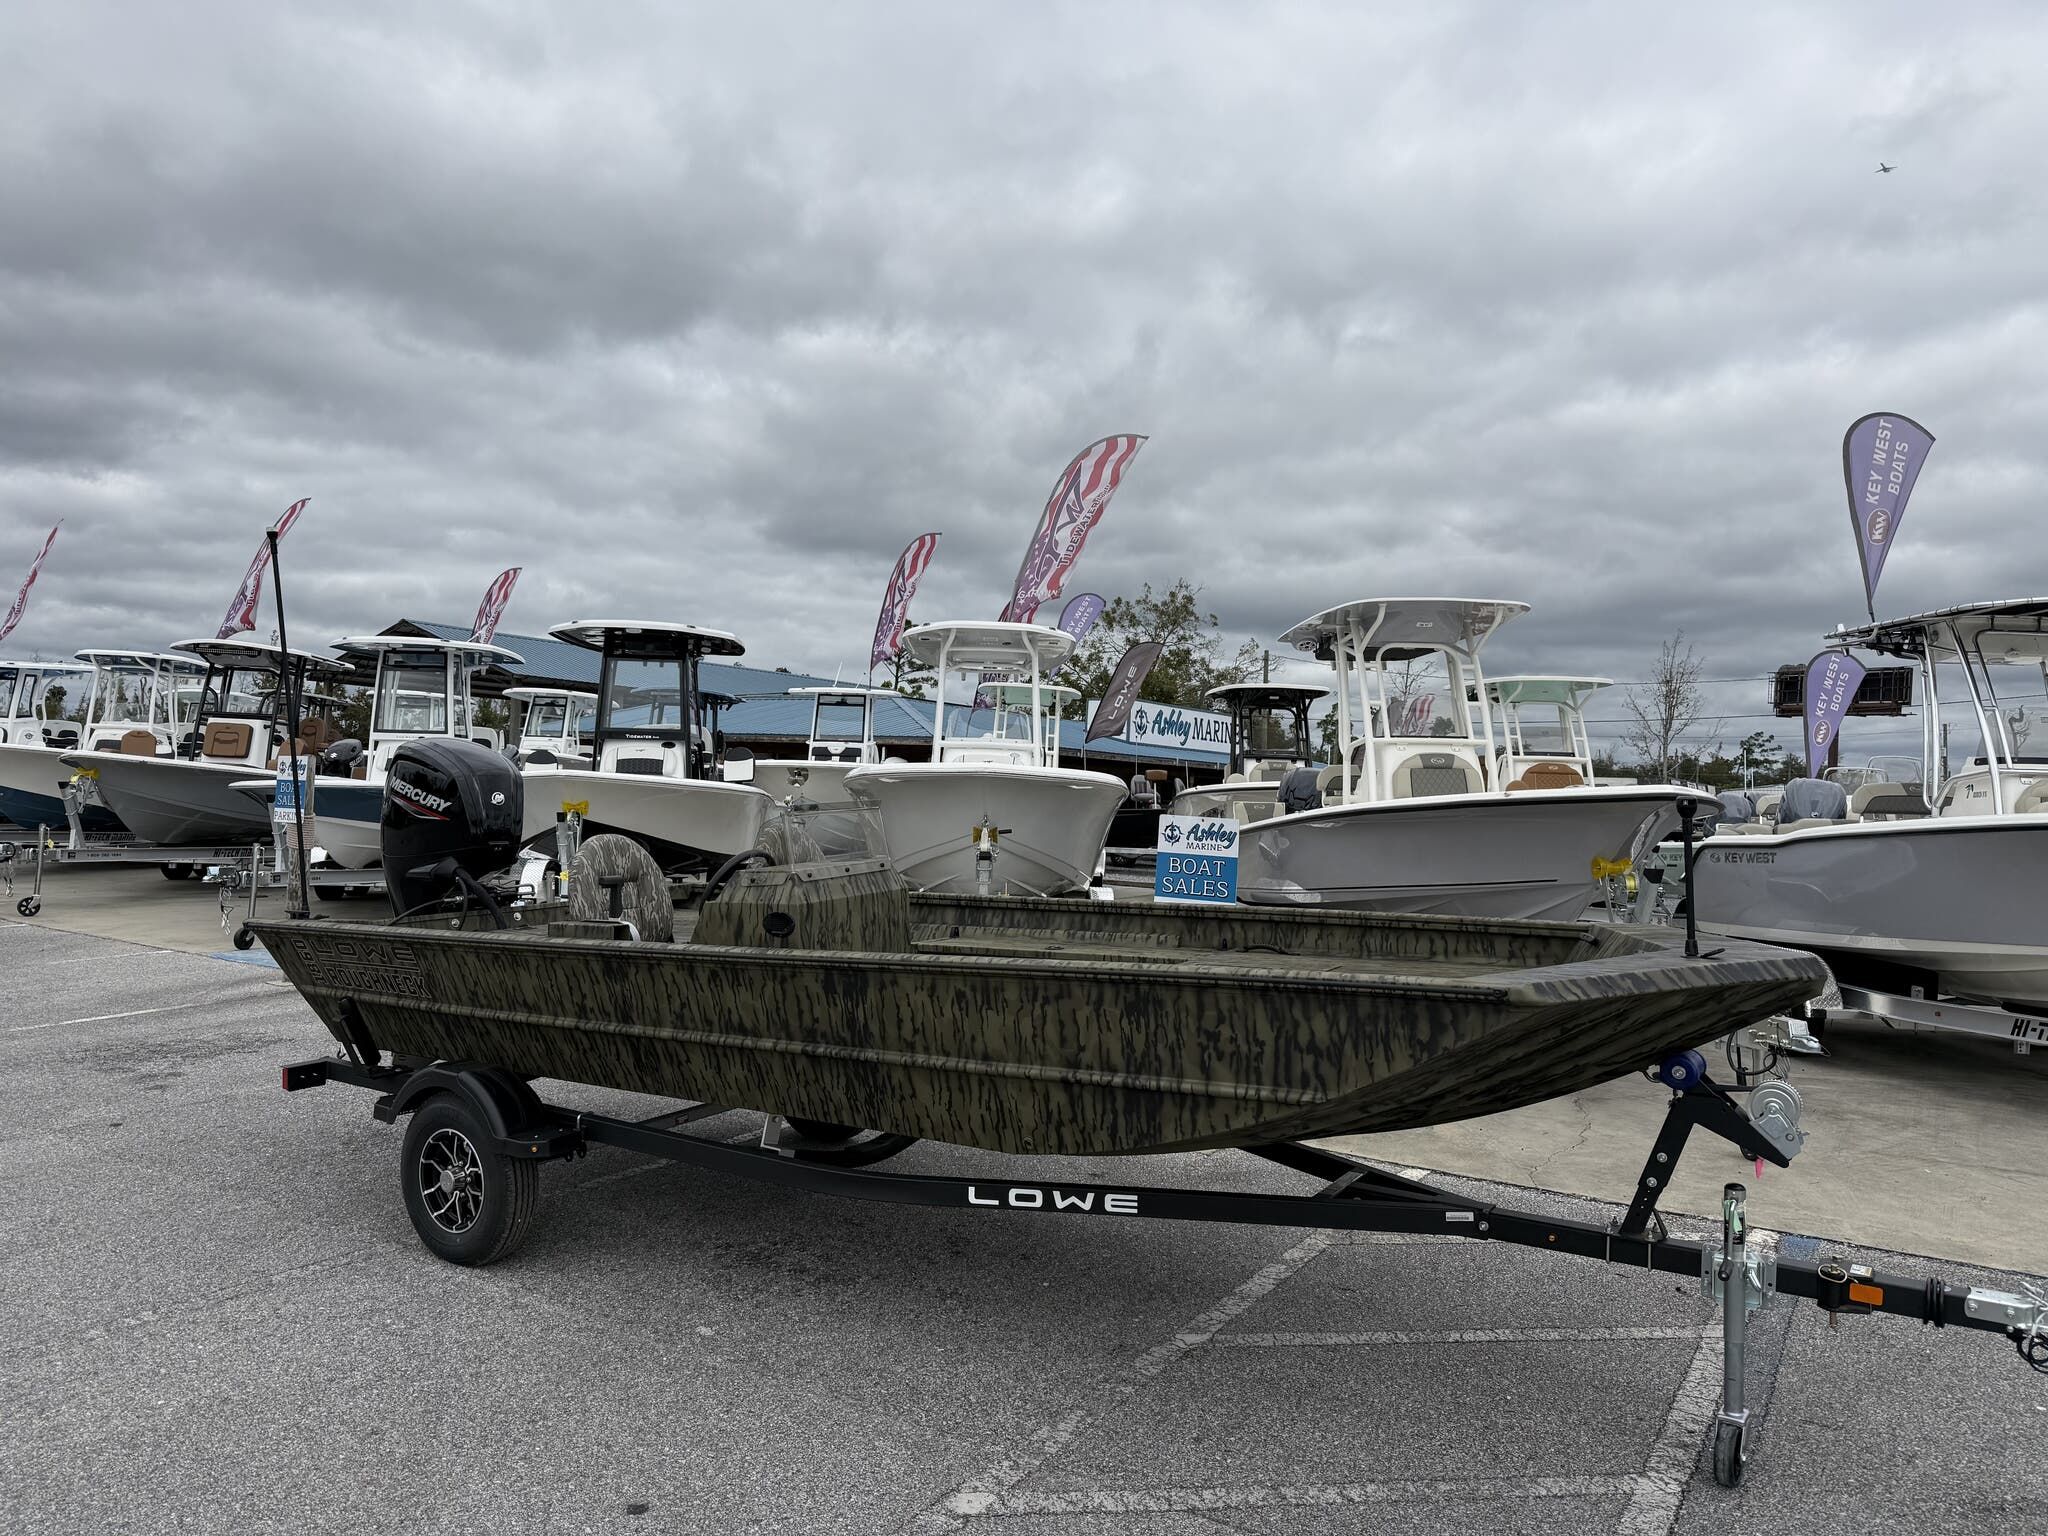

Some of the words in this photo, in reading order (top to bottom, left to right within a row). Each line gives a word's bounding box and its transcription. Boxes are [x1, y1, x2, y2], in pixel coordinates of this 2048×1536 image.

[1872, 419, 1893, 466] WEST
[1888, 441, 1909, 496] BOATS
[1866, 470, 1883, 505] KEY
[1017, 586, 1059, 599] GARIN
[1074, 596, 1091, 619] WEST
[1074, 607, 1094, 634] BOATS
[1108, 663, 1138, 720] LOWE
[1815, 692, 1829, 717] KEY
[1824, 655, 1841, 689] WEST
[1830, 672, 1849, 711] BOATS
[1151, 708, 1191, 746] Ashley
[1192, 717, 1240, 745] MARIN
[277, 794, 302, 806] SALE
[390, 776, 452, 812] MERCURY
[1186, 822, 1237, 849] Ashley
[1186, 842, 1222, 851] MARINE
[1168, 857, 1226, 877] BOAT
[1724, 852, 1745, 864] KEY
[1745, 852, 1777, 864] WEST
[1162, 876, 1229, 898] SALES
[310, 940, 417, 963] LOWE
[325, 966, 432, 999] ROUGHNECK
[2010, 1018, 2048, 1042] HI-T
[968, 1186, 1138, 1214] LOWE
